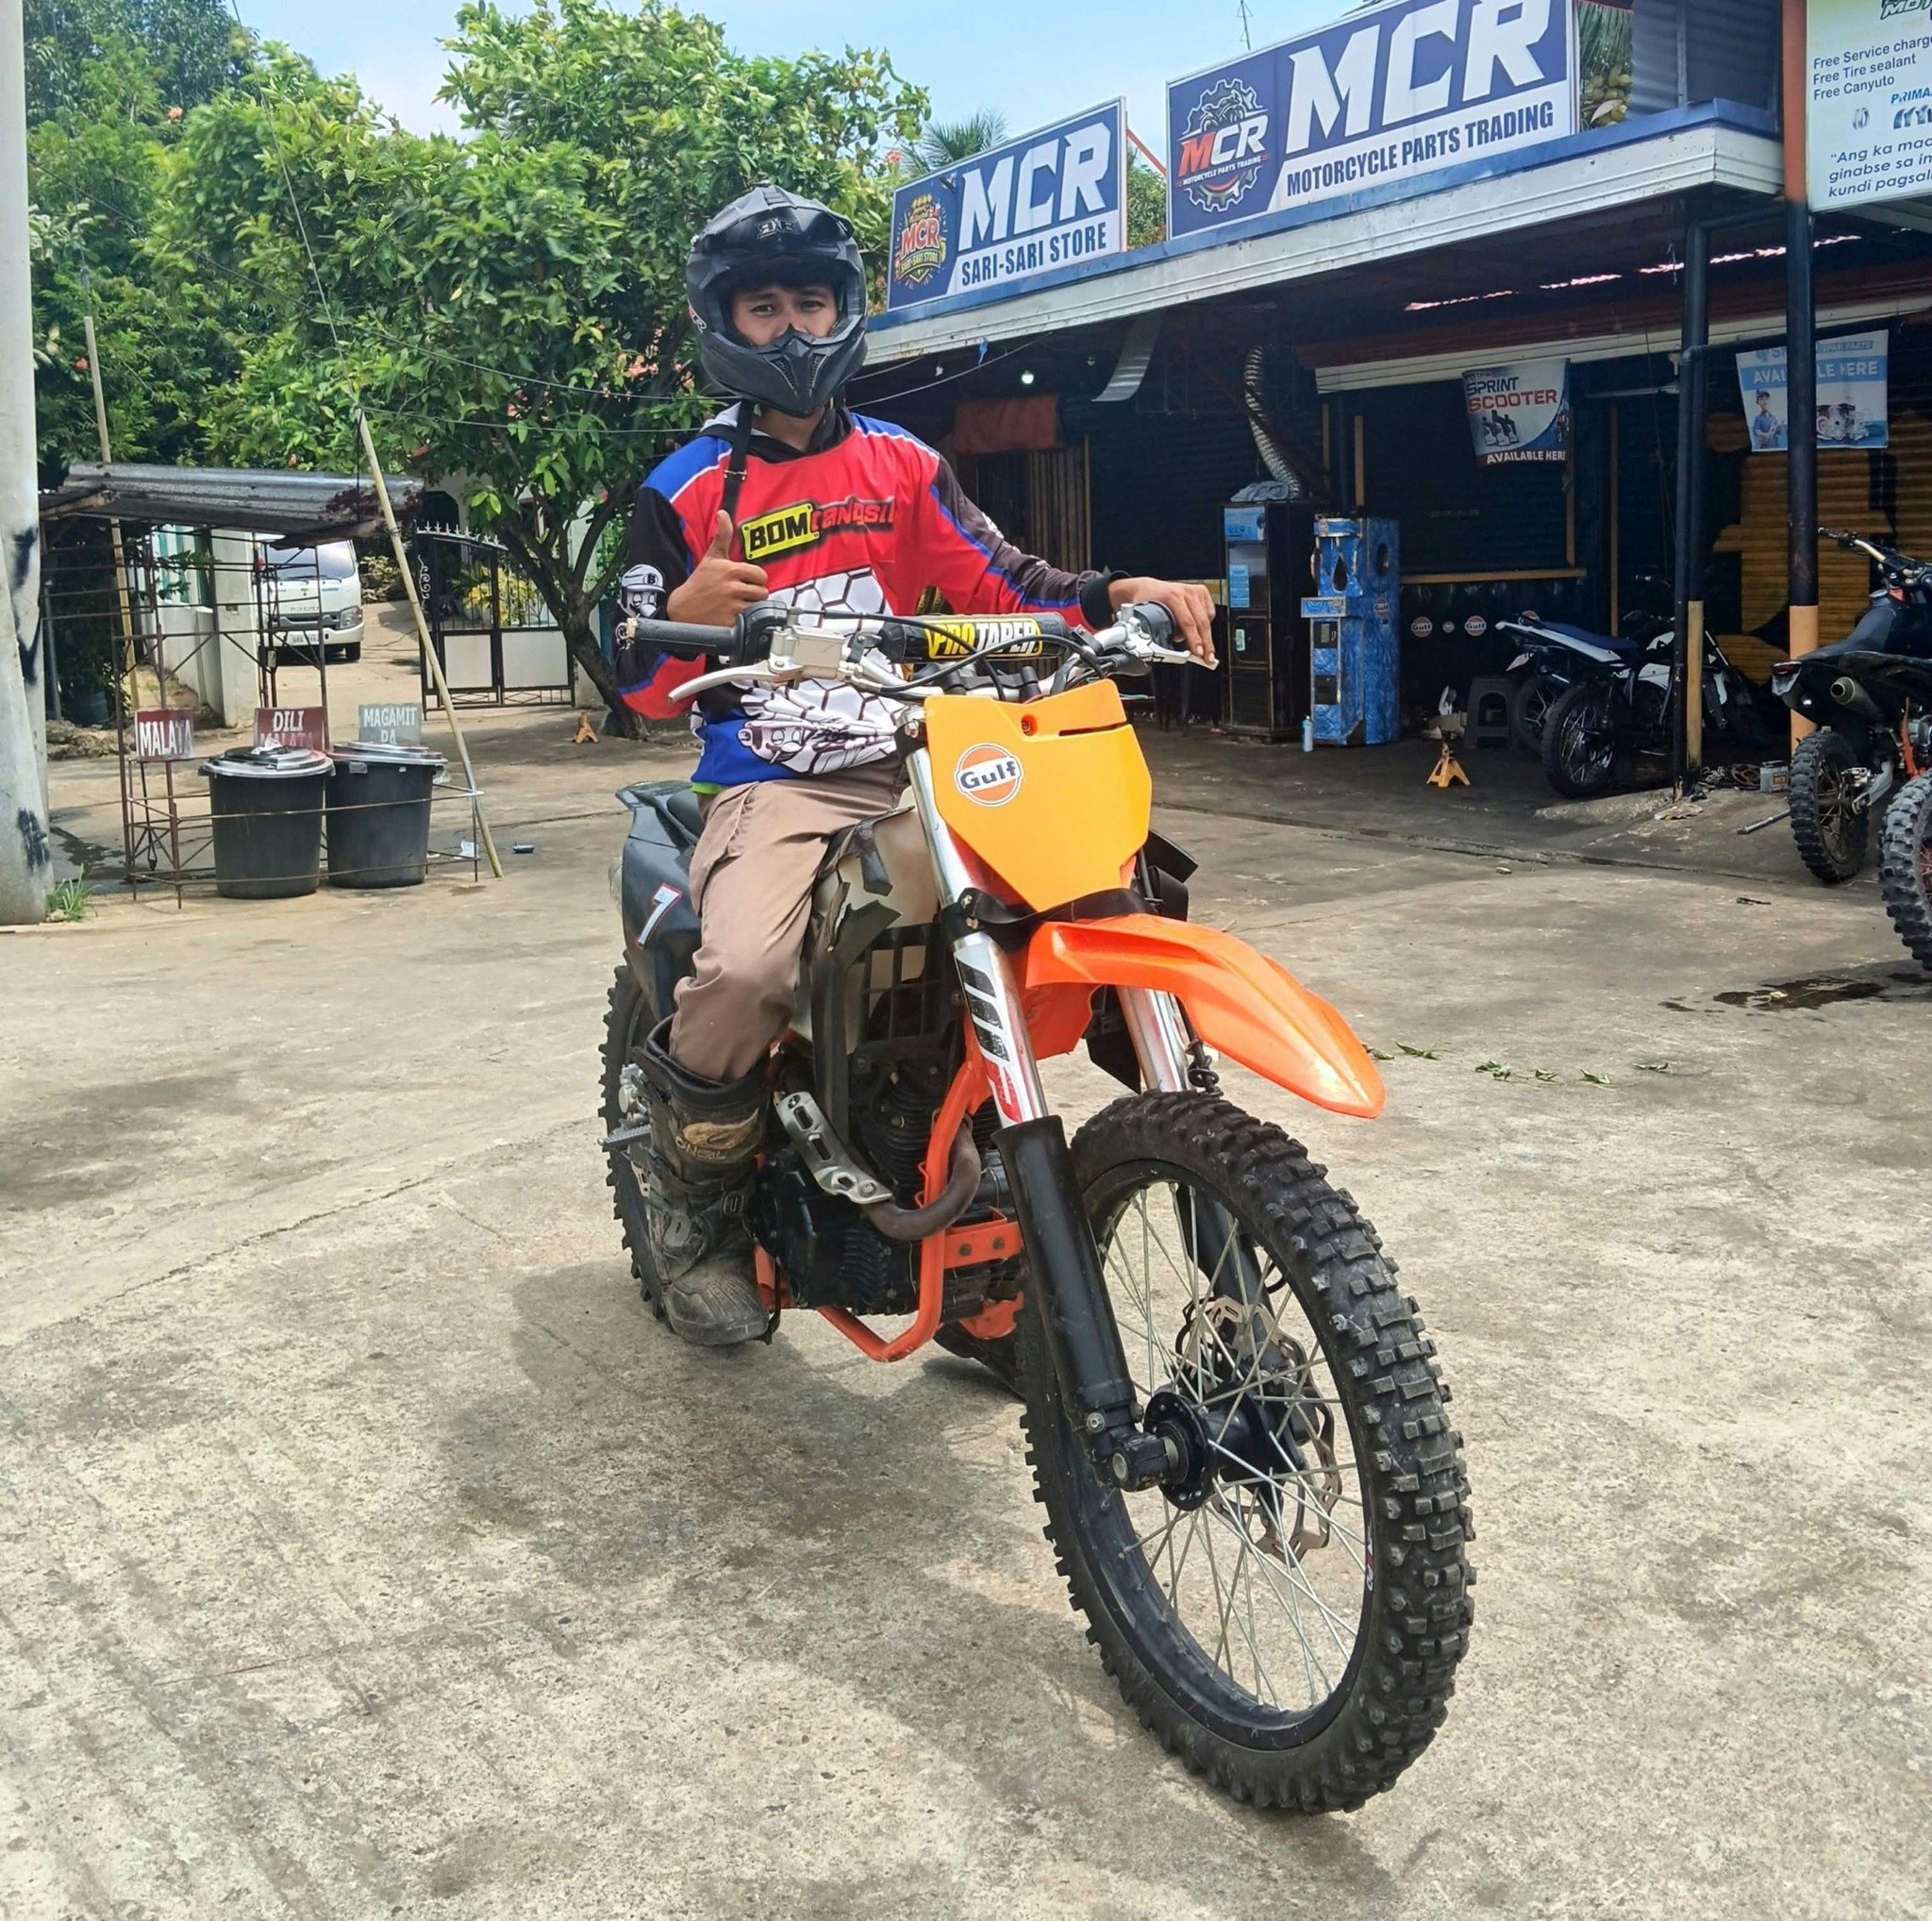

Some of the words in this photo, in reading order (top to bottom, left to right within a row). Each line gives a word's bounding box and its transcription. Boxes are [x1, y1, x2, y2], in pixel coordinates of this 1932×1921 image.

[1813, 57, 1840, 70] Free
[1843, 45, 1890, 63] Service
[1813, 72, 1840, 85] Free
[1842, 66, 1867, 78] Tire
[1870, 53, 1916, 73] sealant
[1286, 0, 1550, 154] MCR
[1814, 87, 1840, 101] Free
[1843, 75, 1894, 94] Canyuto
[1891, 87, 1932, 104] PRIMA
[1178, 114, 1268, 177] MCR
[1287, 143, 1398, 196] MOTORCYCLE
[1402, 126, 1460, 166] PARTS
[1465, 101, 1555, 147] TRADING
[1873, 144, 1892, 157] ka
[1828, 179, 1872, 198] kundi
[1875, 169, 1932, 192] pagsal
[1829, 162, 1890, 183] ginabse
[1896, 158, 1913, 169] sa
[958, 121, 1111, 252] MCR
[901, 217, 941, 259] MCR
[961, 241, 1044, 287] SARI-SARI
[1050, 222, 1108, 263] STORE
[1467, 376, 1520, 396] SPRINT
[1469, 389, 1557, 412] SCOOTER
[1487, 451, 1543, 464] AVAILABLE
[749, 511, 808, 552] BOM
[273, 710, 304, 732] DILI
[363, 707, 418, 727] MAGAMIT
[139, 719, 193, 757] MALATA
[960, 760, 1016, 789] Gulf
[634, 884, 683, 947] 7
